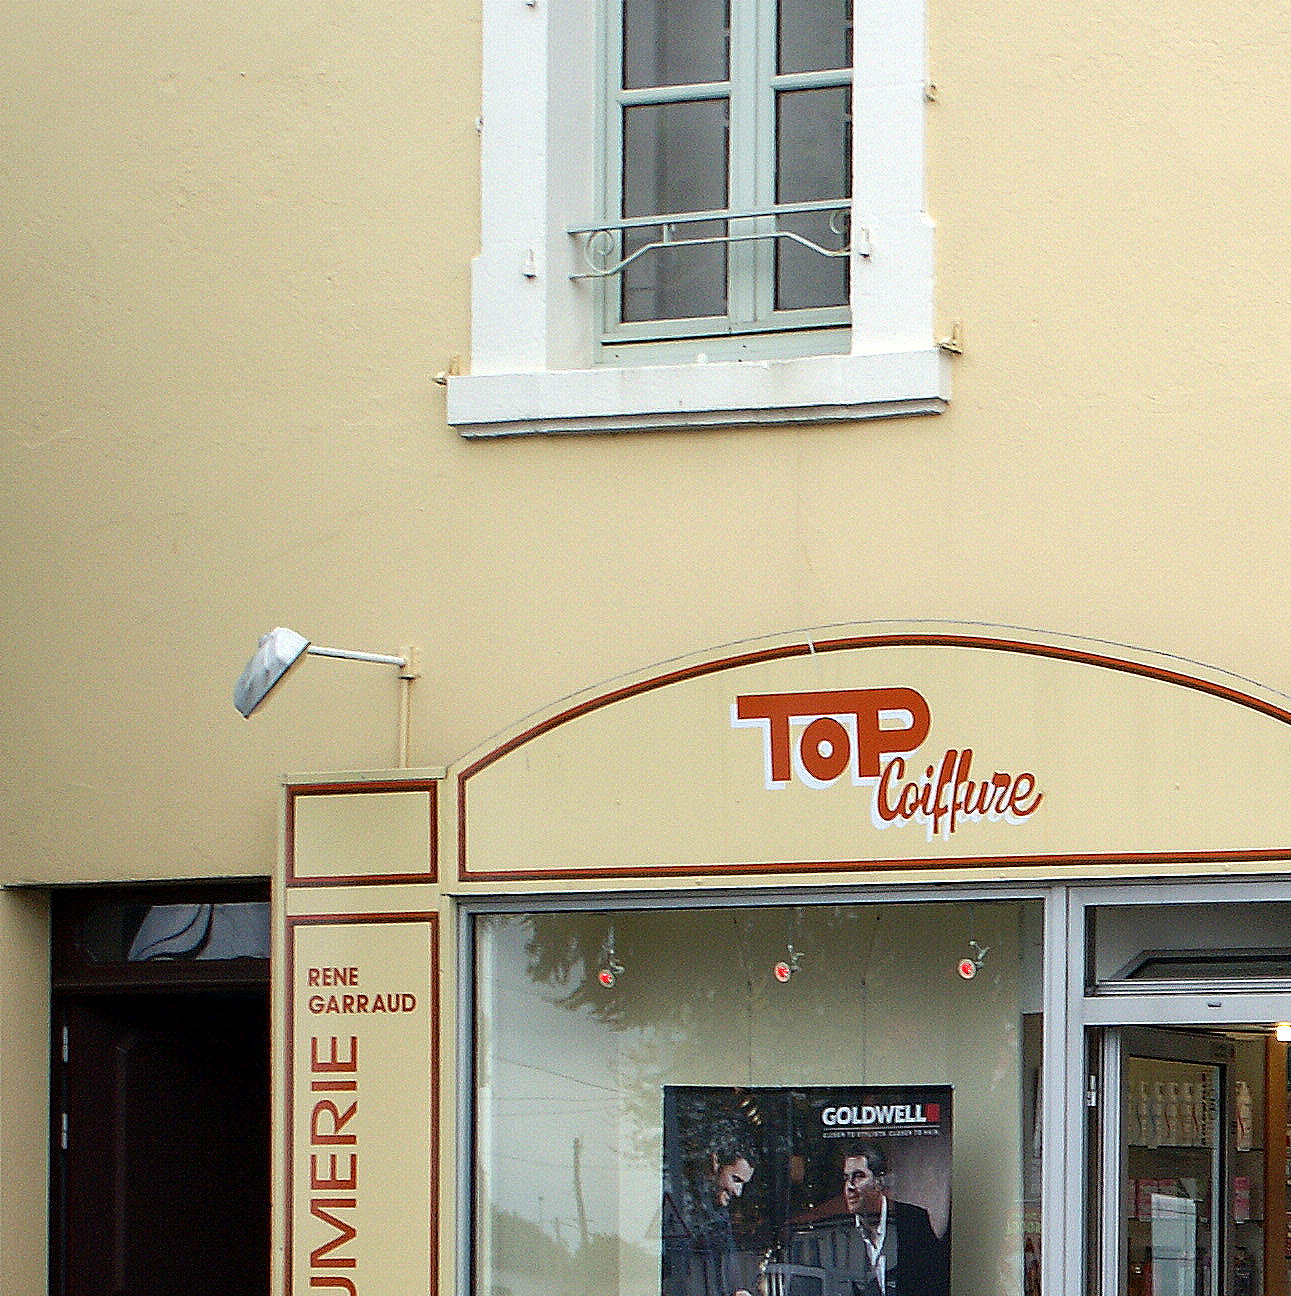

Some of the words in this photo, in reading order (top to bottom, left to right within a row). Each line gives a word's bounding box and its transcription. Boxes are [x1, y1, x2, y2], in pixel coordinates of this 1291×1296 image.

[877, 749, 1044, 834] Coiffure
[308, 968, 359, 987] RENE
[308, 994, 417, 1015] GARRAUD
[822, 1104, 927, 1126] GOLDWELL
